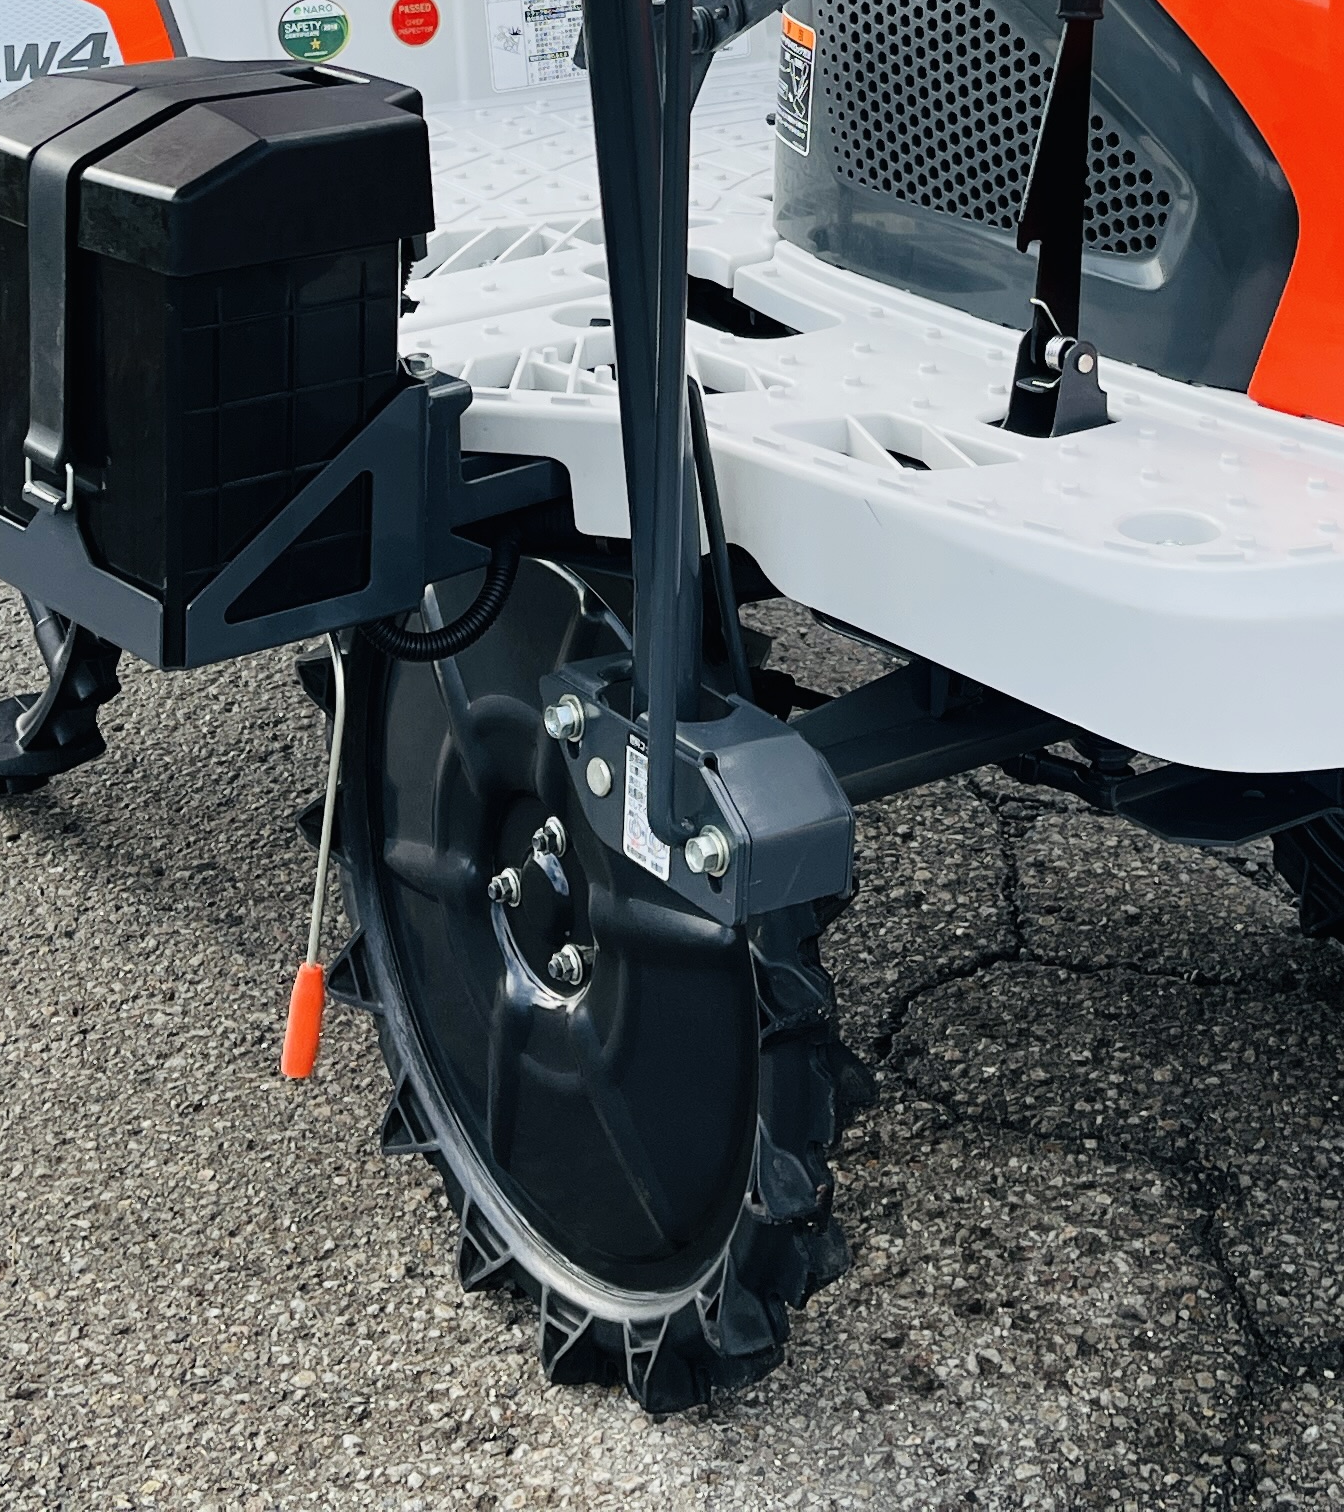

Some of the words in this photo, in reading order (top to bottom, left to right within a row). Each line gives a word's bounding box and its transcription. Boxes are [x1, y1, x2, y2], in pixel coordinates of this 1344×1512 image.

[302, 3, 333, 15] NARO
[398, 2, 432, 15] PASSED
[284, 21, 322, 34] SAFETY
